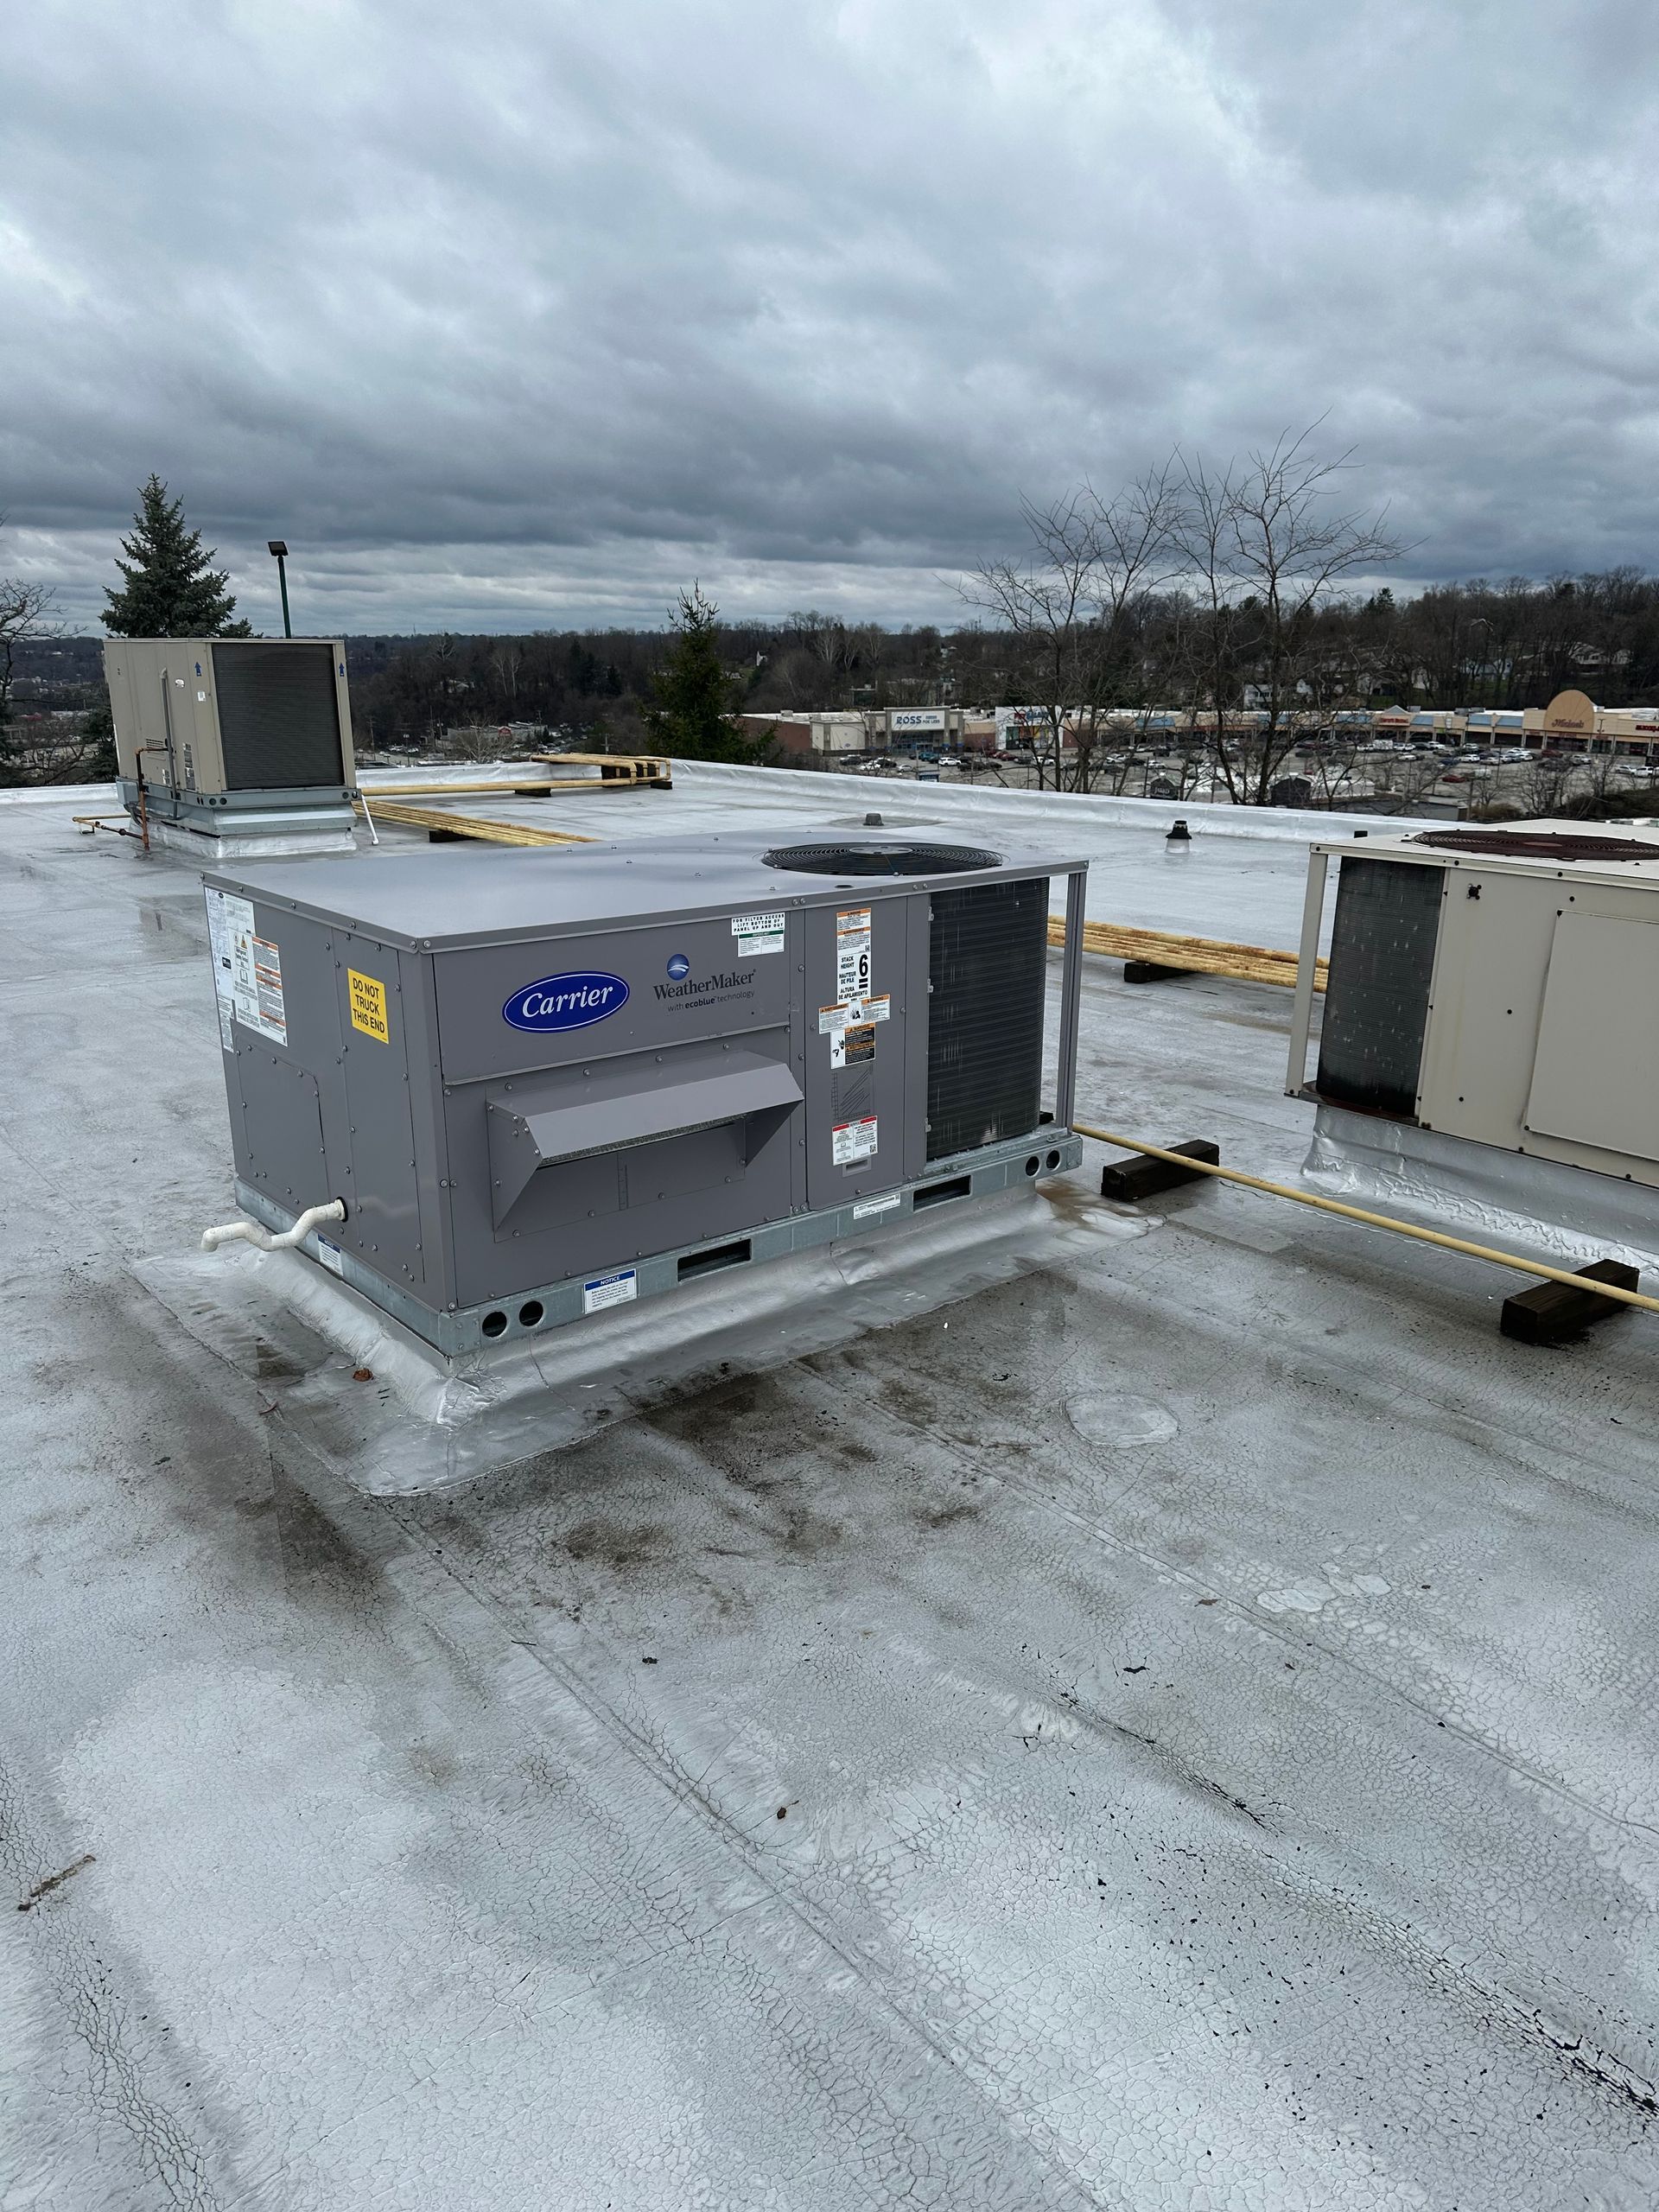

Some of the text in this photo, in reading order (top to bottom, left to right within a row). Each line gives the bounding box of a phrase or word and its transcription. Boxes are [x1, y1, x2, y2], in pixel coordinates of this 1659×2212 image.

[897, 715, 922, 724] ROSS
[859, 954, 868, 976] 6
[353, 977, 379, 1000] DO NOT
[355, 995, 380, 1016] TRUCK
[522, 985, 613, 1018] Carrier
[668, 1002, 684, 1013] with
[717, 990, 755, 1003] technology
[353, 1008, 385, 1033] THIS END
[601, 1275, 620, 1285] NOTICE
